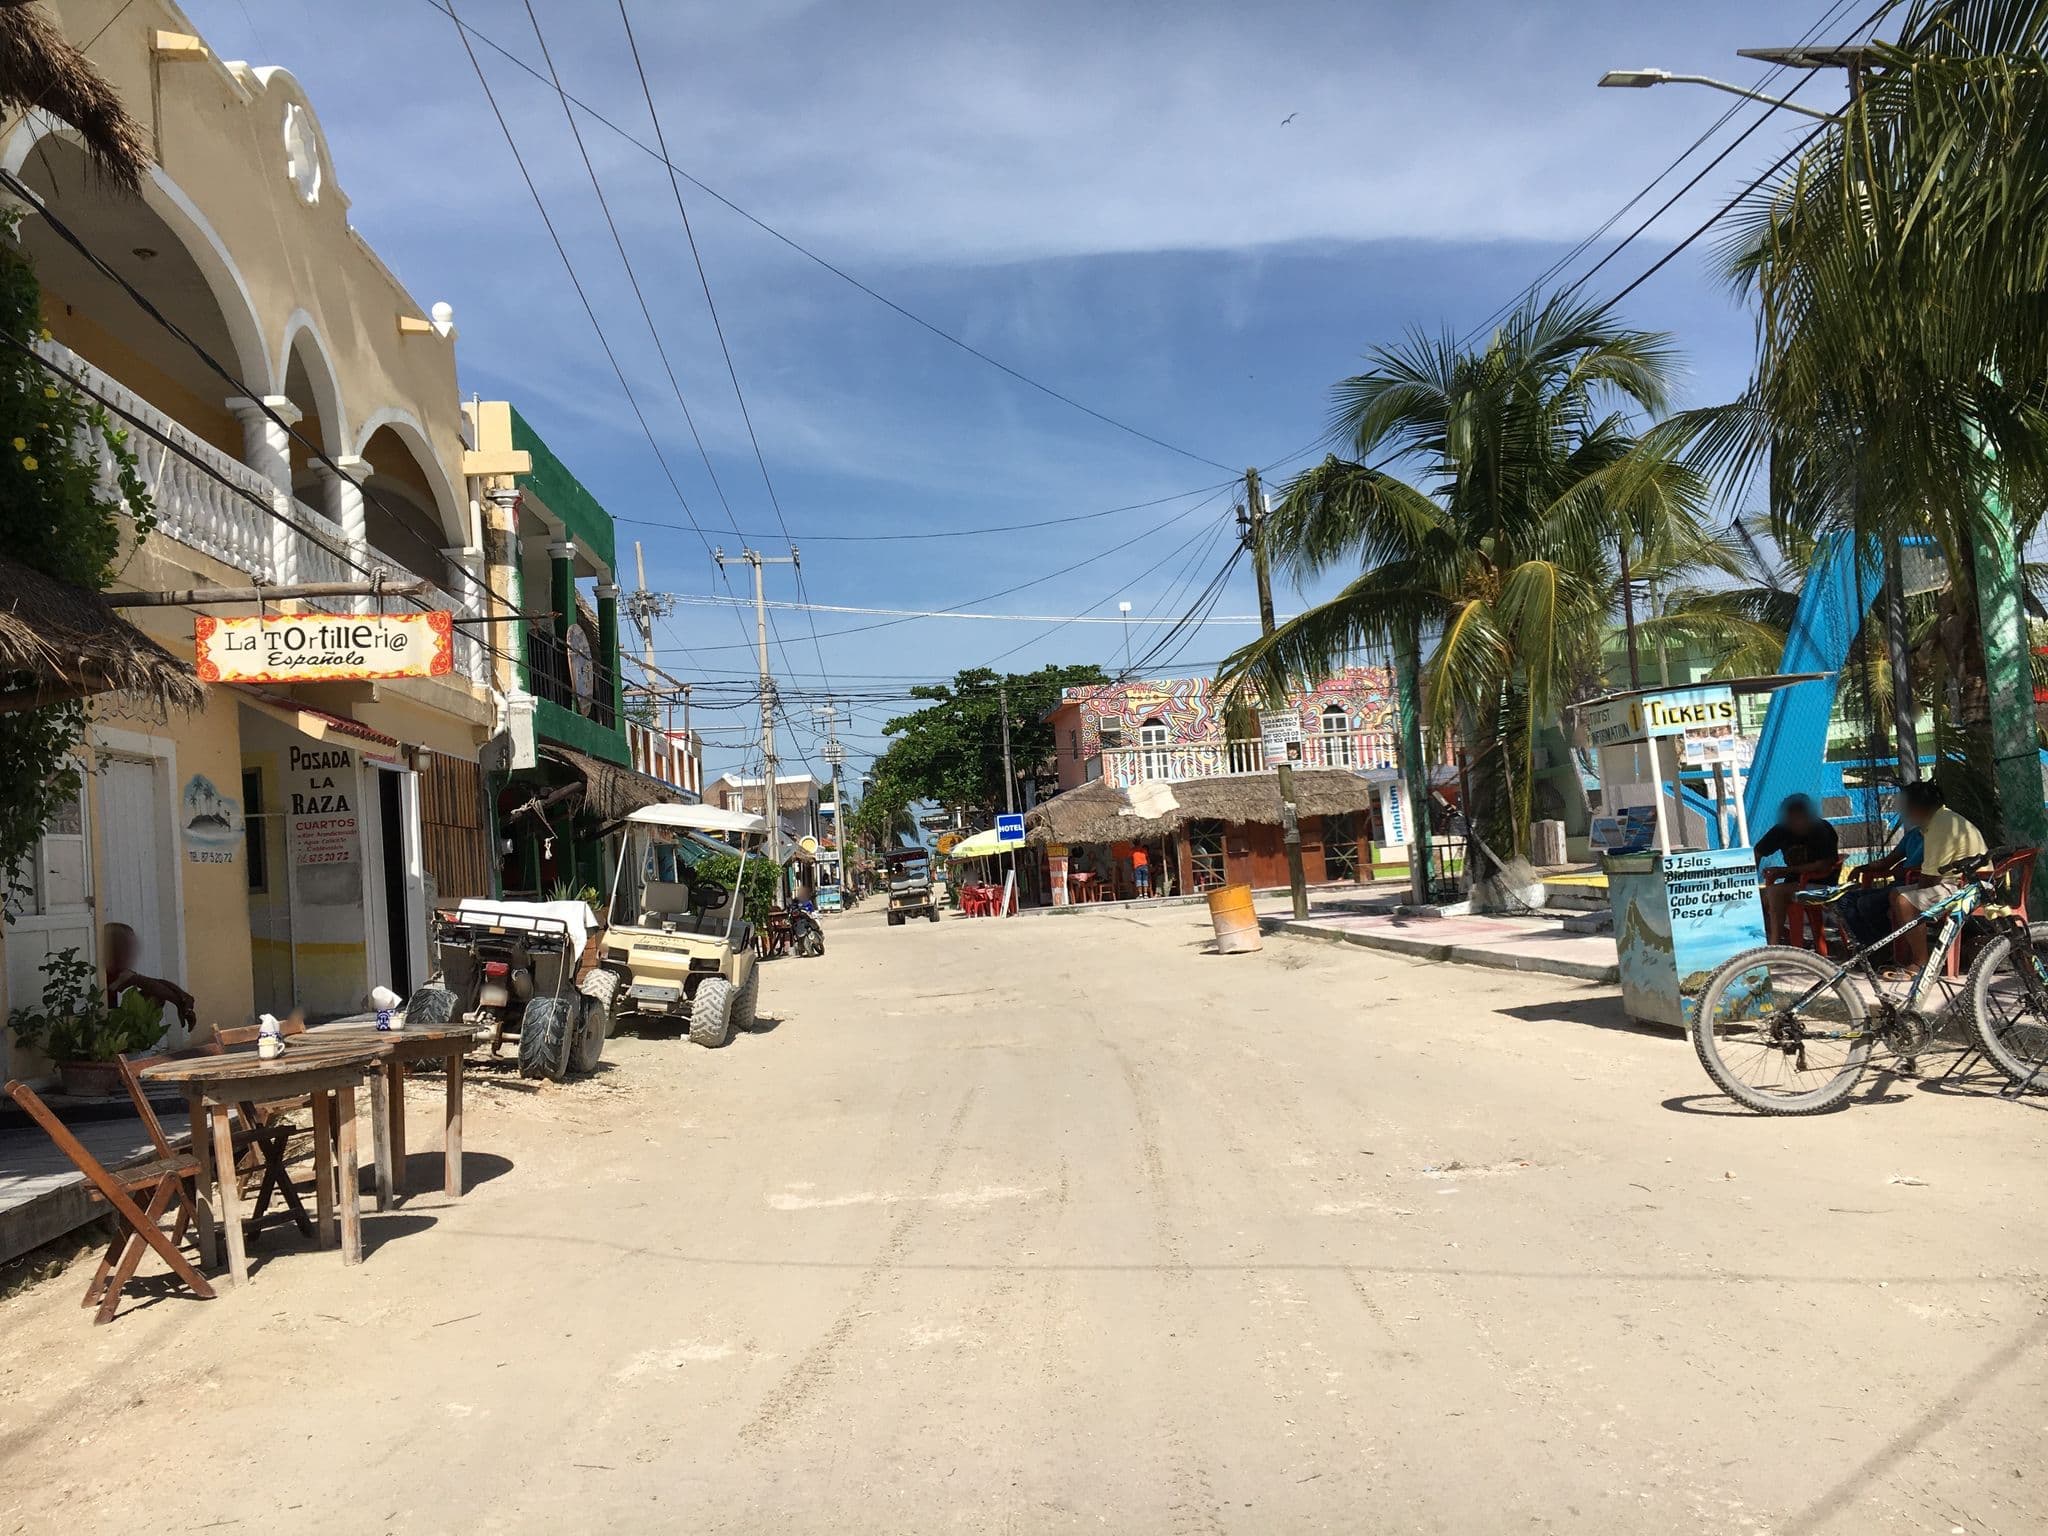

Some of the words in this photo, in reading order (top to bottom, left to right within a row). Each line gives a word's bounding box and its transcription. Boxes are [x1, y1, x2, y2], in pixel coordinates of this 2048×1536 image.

[225, 632, 256, 651] La
[268, 651, 367, 669] Española
[1643, 701, 1732, 726] TICKETS
[289, 746, 350, 771] POSADA
[310, 777, 334, 789] LA
[291, 794, 351, 815] RAZA
[1390, 786, 1404, 842] infinitum
[296, 819, 355, 830] CUARTOS
[999, 824, 1023, 832] HOTEL
[1664, 858, 1673, 870] 3
[1677, 856, 1711, 869] Islas
[1712, 878, 1755, 892] Ballena
[1670, 895, 1698, 907] Cabo
[1702, 889, 1753, 904] Catoche
[1672, 908, 1712, 919] Pesca
[1917, 918, 1955, 994] GRISLEY
